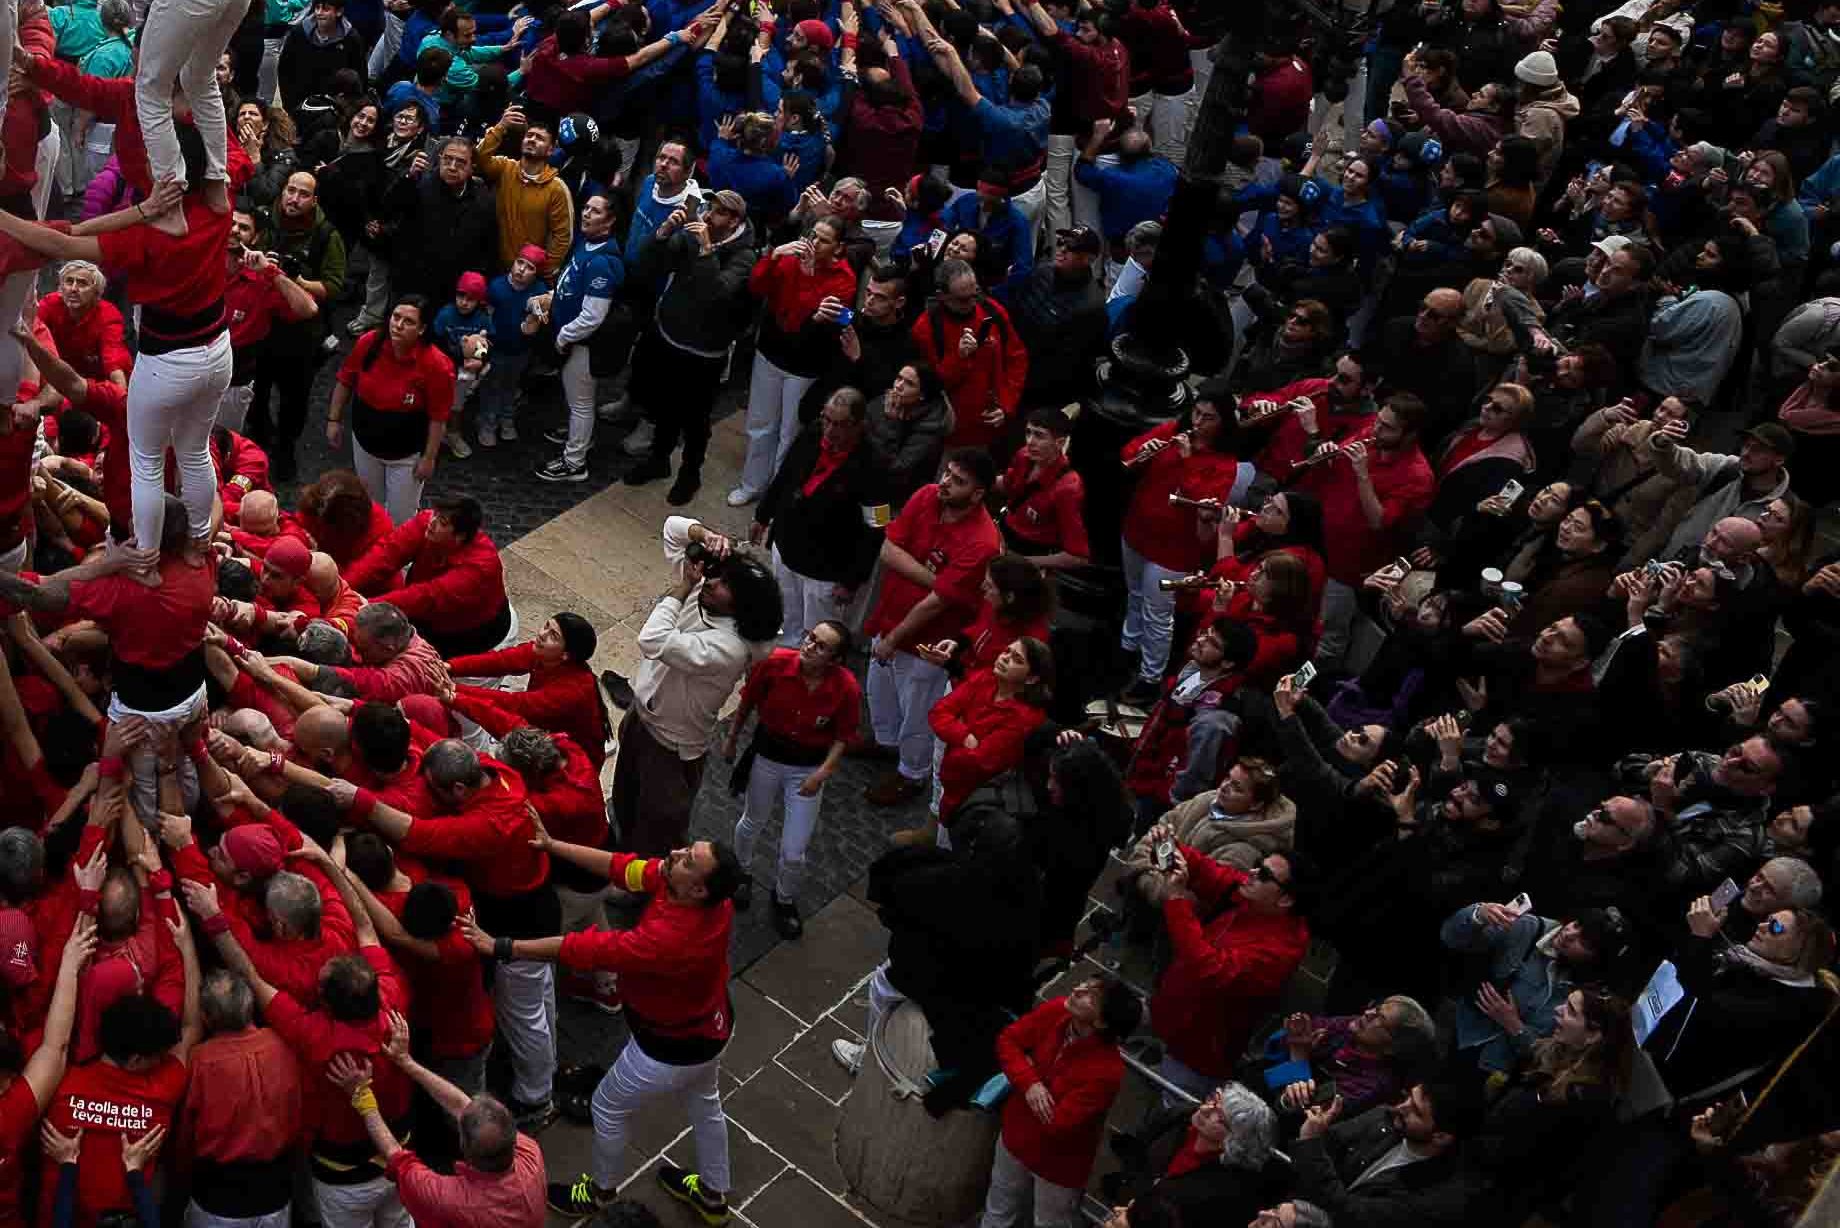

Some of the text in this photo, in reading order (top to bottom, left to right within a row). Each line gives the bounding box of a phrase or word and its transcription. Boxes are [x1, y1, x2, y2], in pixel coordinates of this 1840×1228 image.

[69, 1095, 153, 1118] La colla de la
[72, 1107, 147, 1129] teva ciutat
